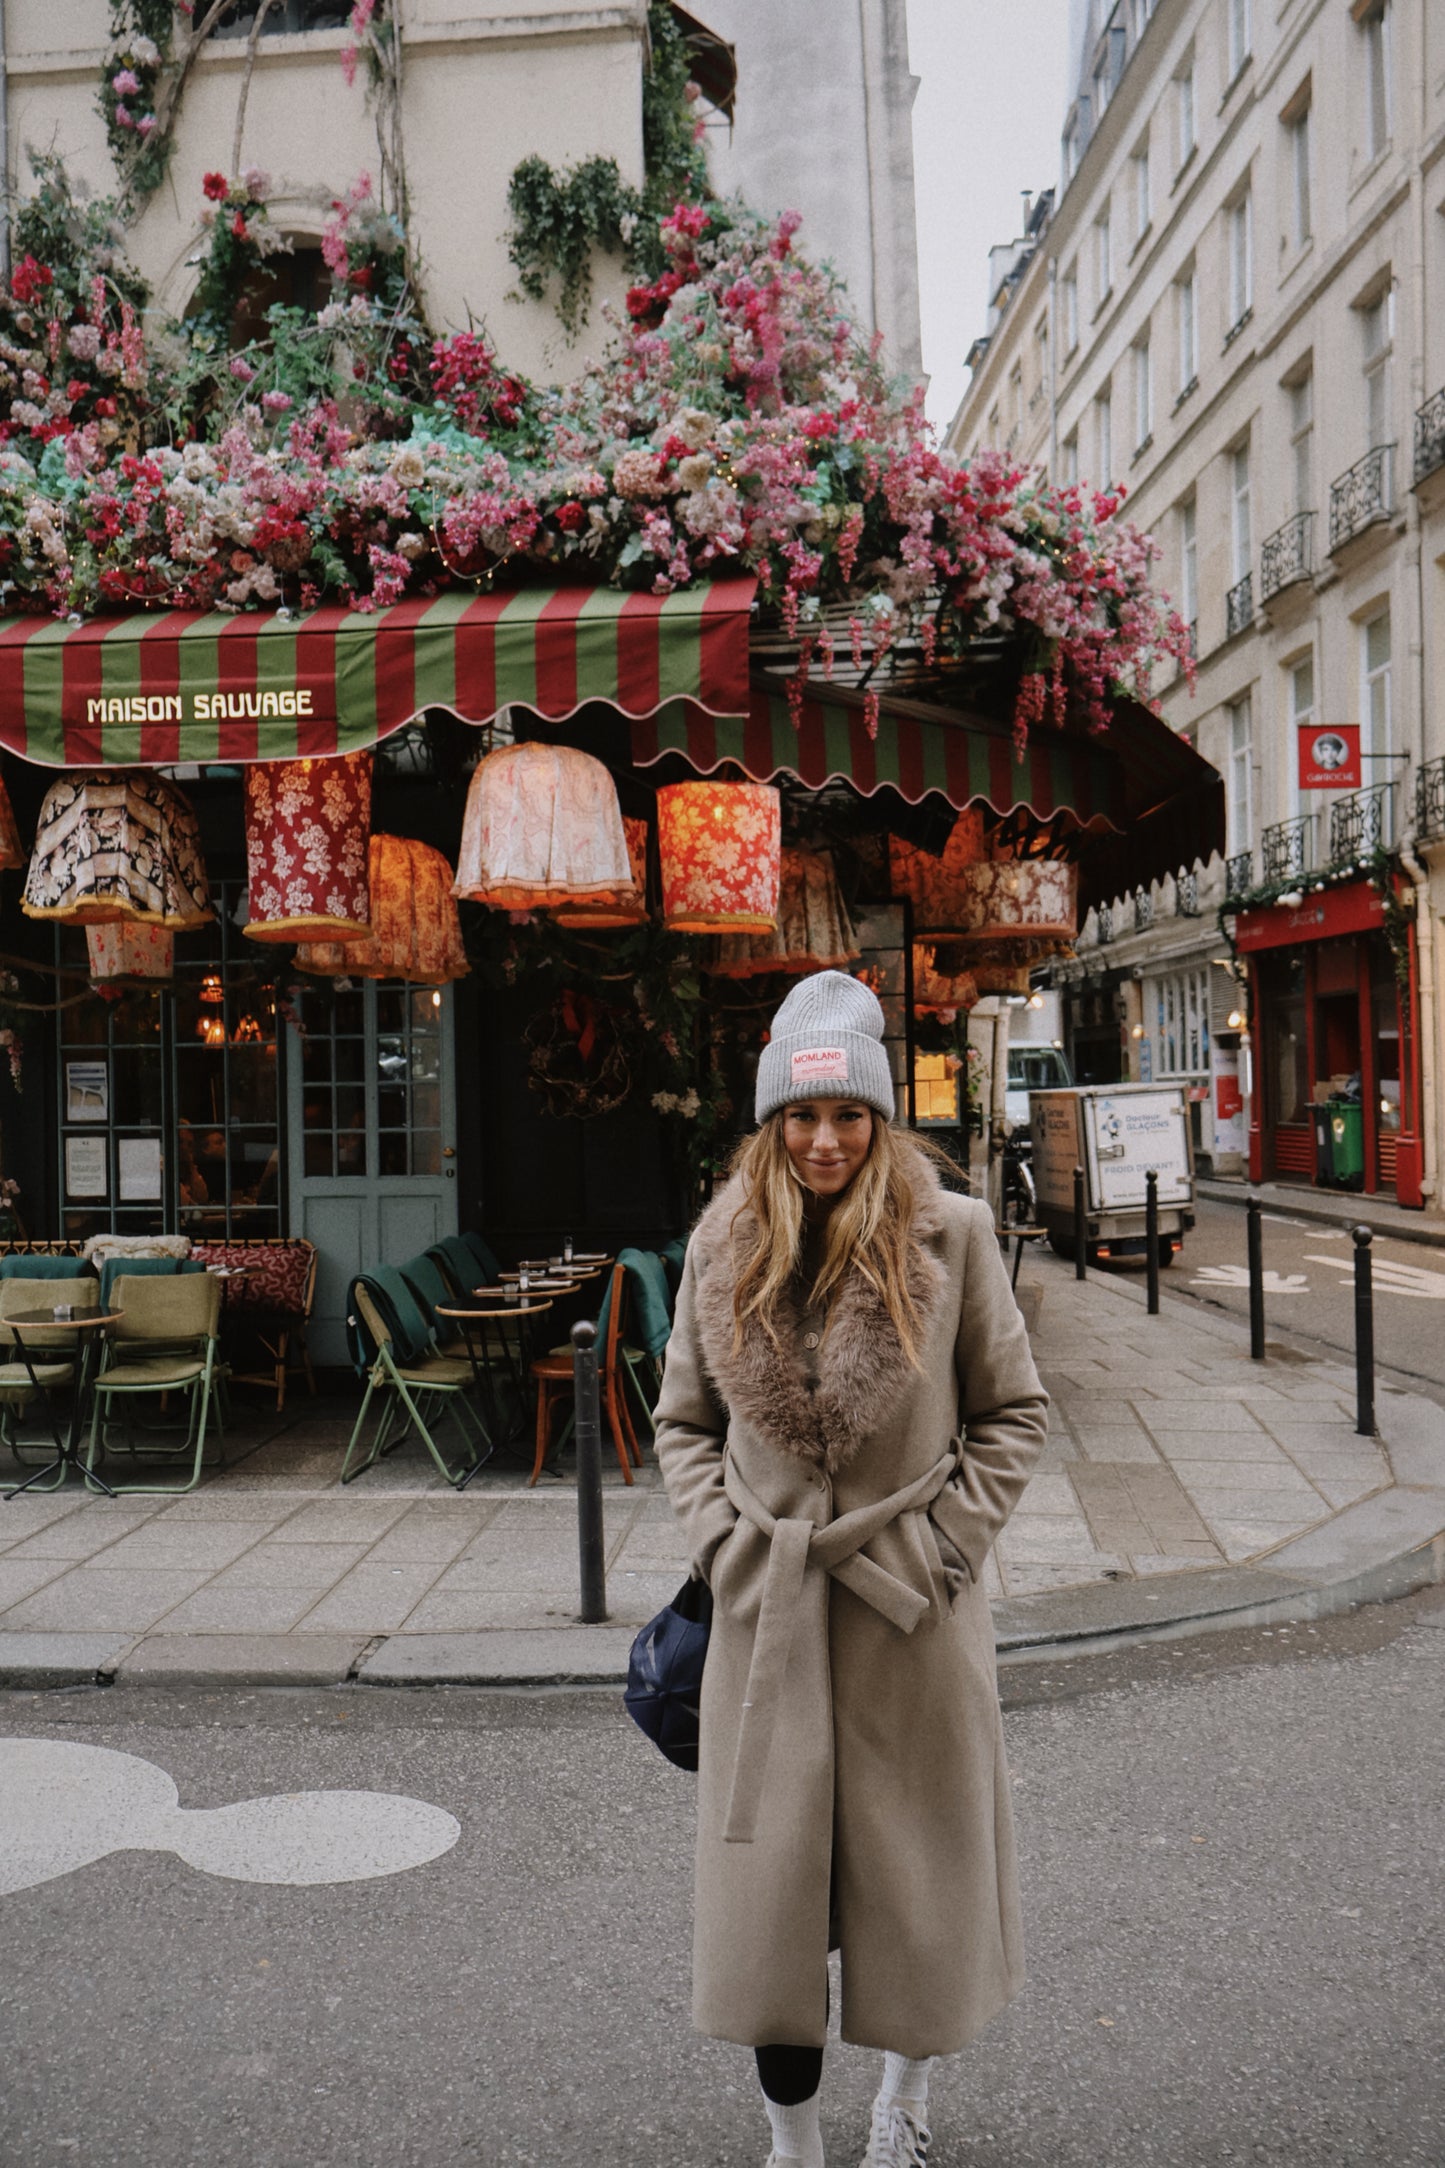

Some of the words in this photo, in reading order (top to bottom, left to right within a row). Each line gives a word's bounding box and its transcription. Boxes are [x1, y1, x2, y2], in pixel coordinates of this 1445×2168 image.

[87, 695, 182, 723] MAISON
[194, 690, 314, 720] SAUVAGE
[793, 1051, 842, 1065] MOMLAND
[1126, 1120, 1169, 1131] GLAÇONS
[1104, 1164, 1134, 1174] FROID
